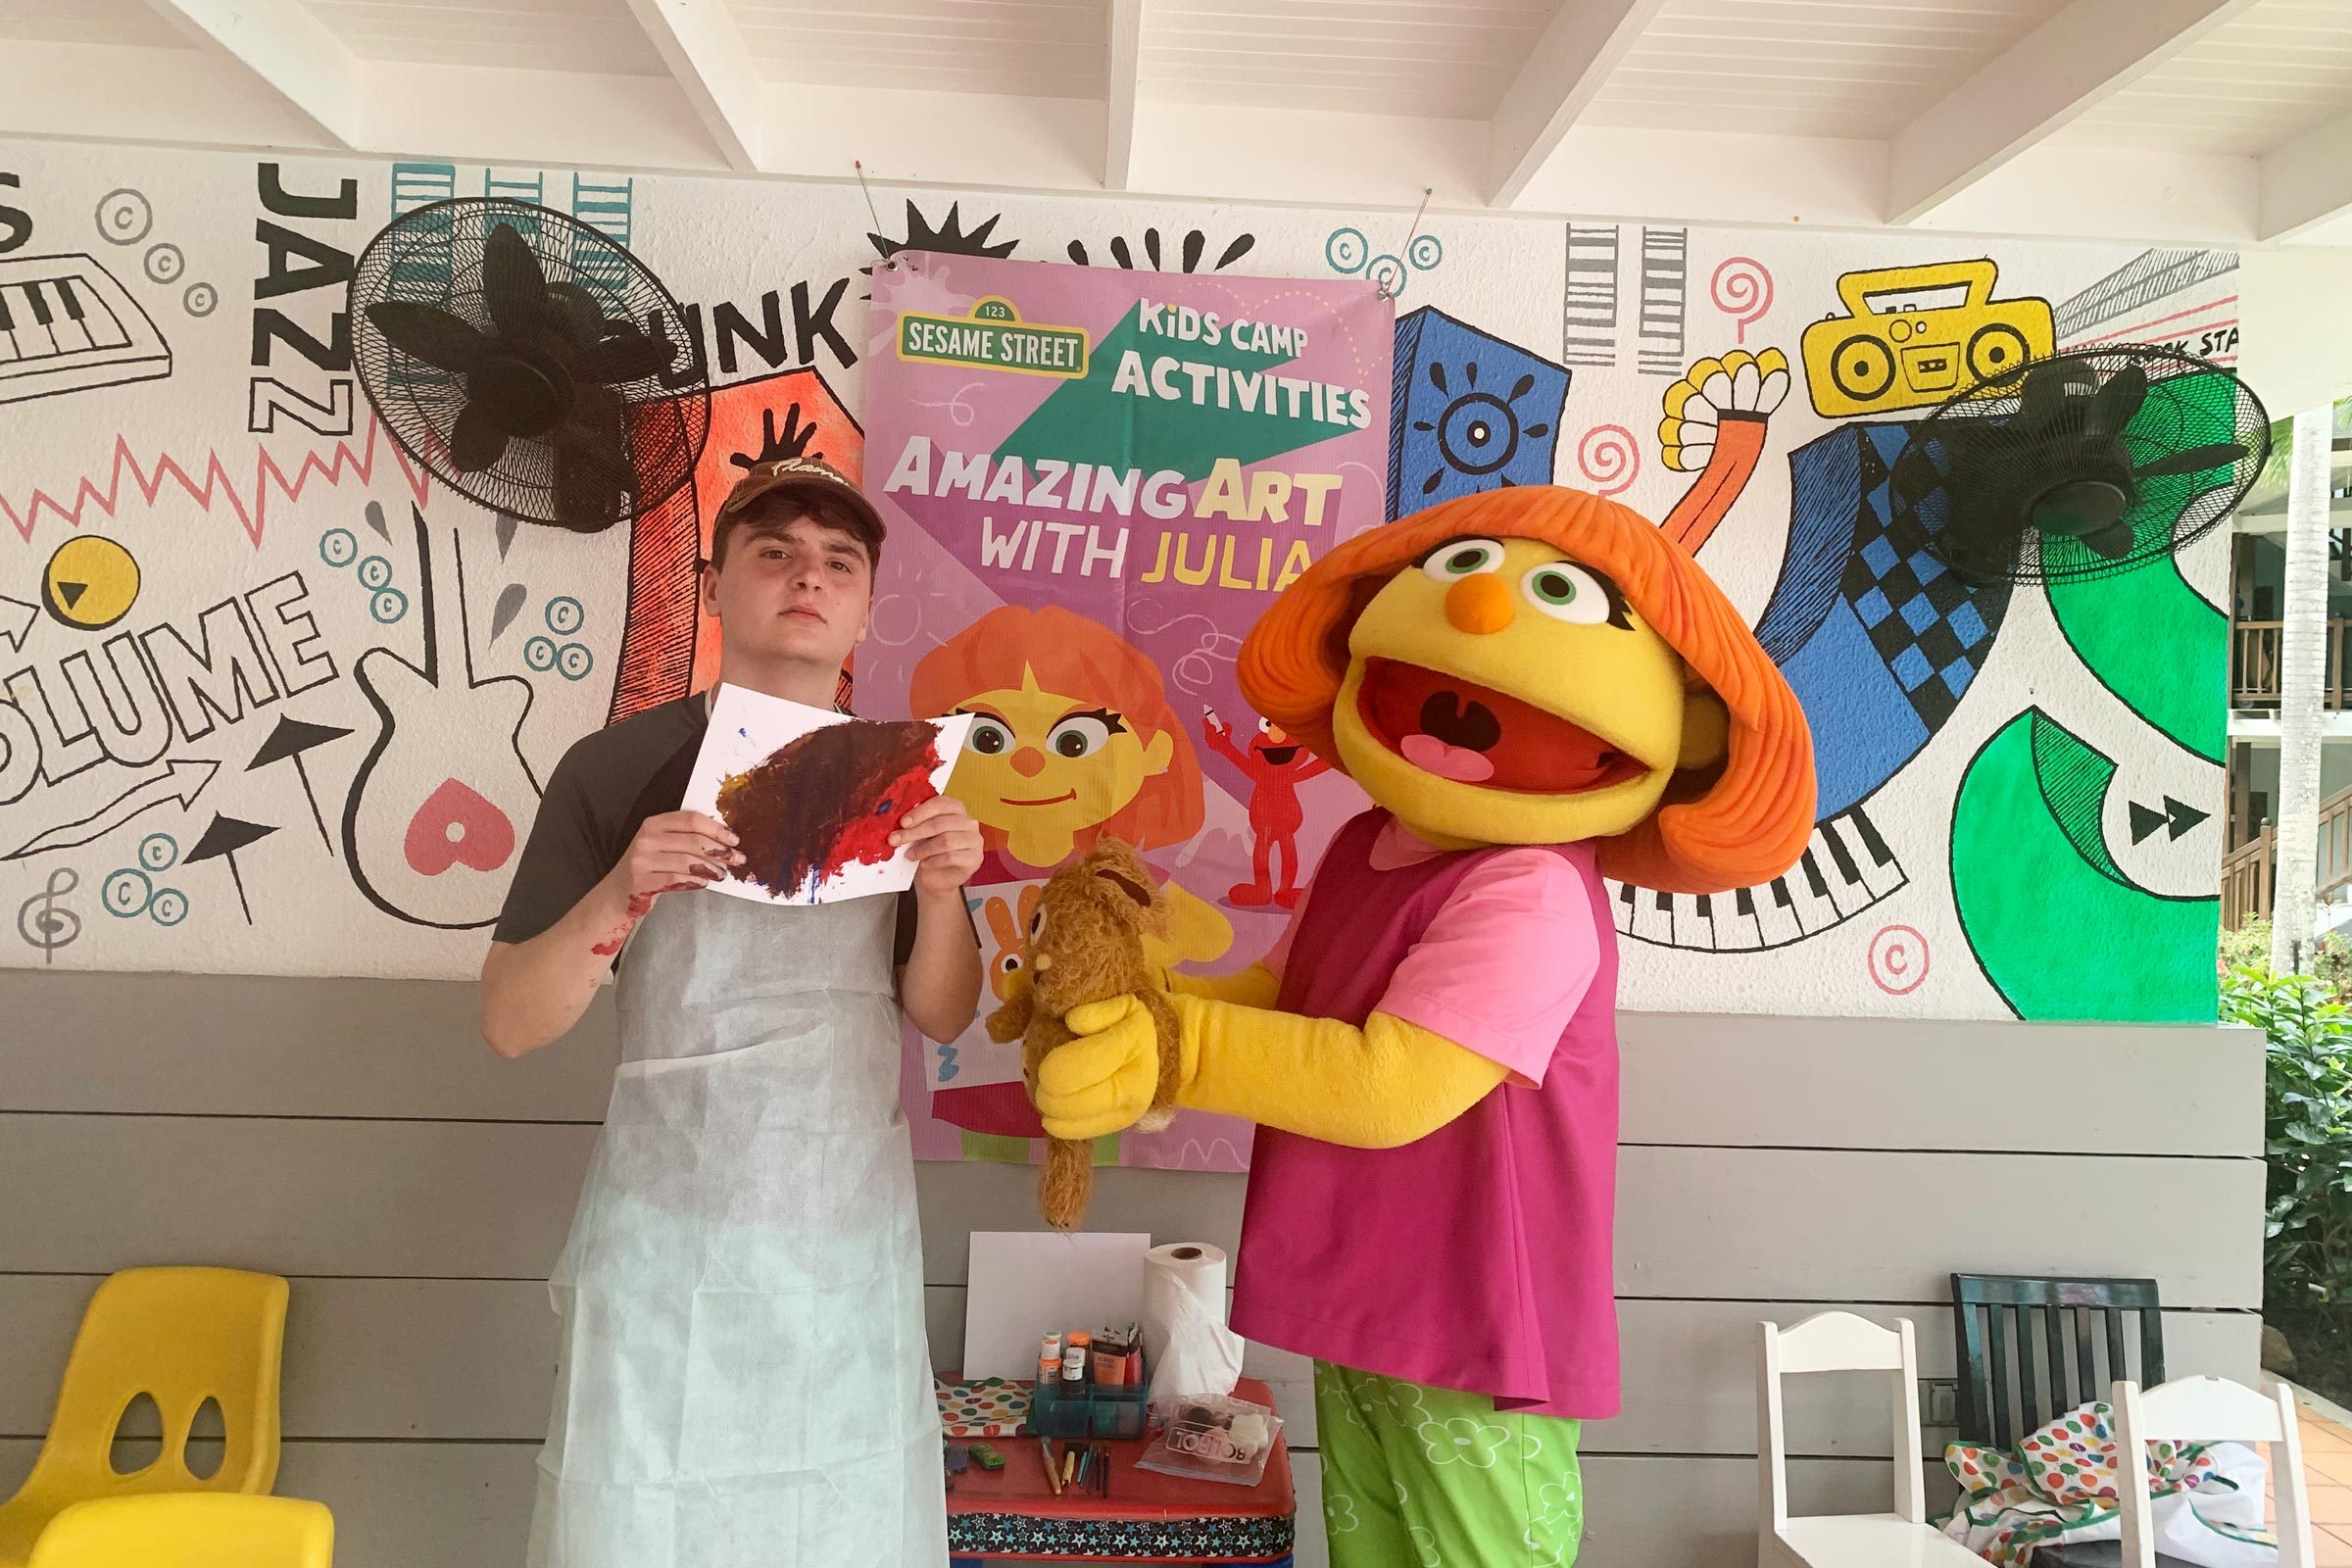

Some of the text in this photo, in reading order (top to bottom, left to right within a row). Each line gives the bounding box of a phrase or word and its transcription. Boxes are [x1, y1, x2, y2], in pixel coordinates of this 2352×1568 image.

[248, 163, 358, 435] JAZZ
[985, 306, 1005, 318] 123
[908, 322, 1078, 368] SESAME STREET
[1230, 318, 1308, 358] CAMP
[1111, 350, 1372, 429] ACTIVITIES
[883, 436, 1343, 526] AMAZING ART
[982, 516, 1312, 593] WITH JULIA
